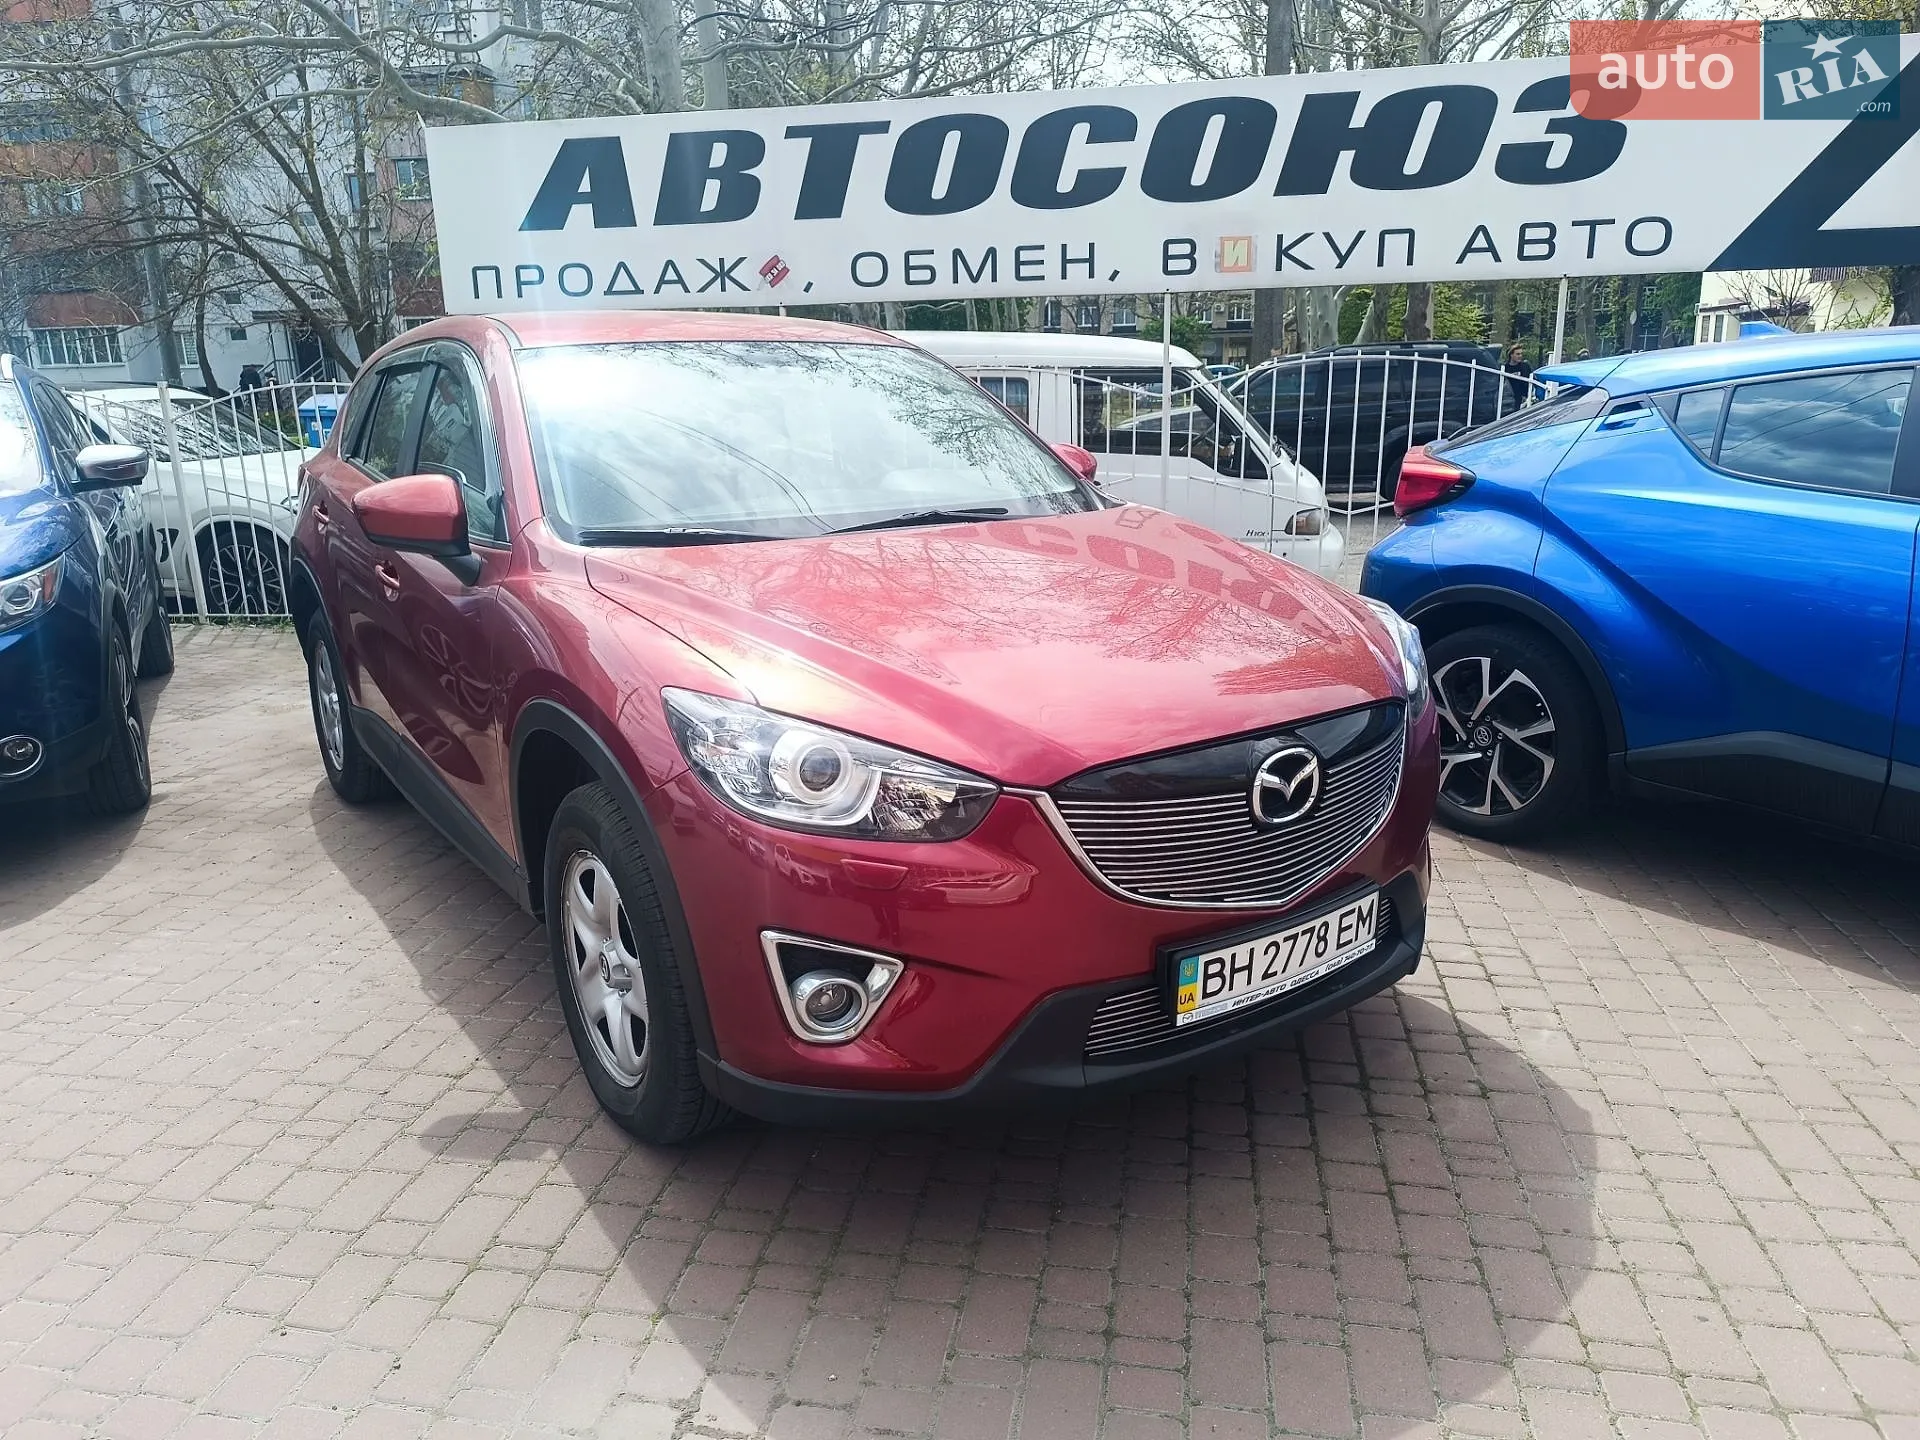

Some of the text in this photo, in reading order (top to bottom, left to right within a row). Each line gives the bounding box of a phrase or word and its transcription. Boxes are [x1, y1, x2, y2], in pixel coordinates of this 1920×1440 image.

[518, 73, 1643, 232] АВТОСОЮЗ
[471, 252, 814, 300] ПРОДАЖ,
[850, 242, 1120, 288] ОБМЕН,
[1162, 227, 1416, 276] ВИКУП
[1455, 216, 1673, 265] АВТО
[1201, 898, 1376, 1001] BH 2778 EM
[1179, 992, 1195, 1006] UA
